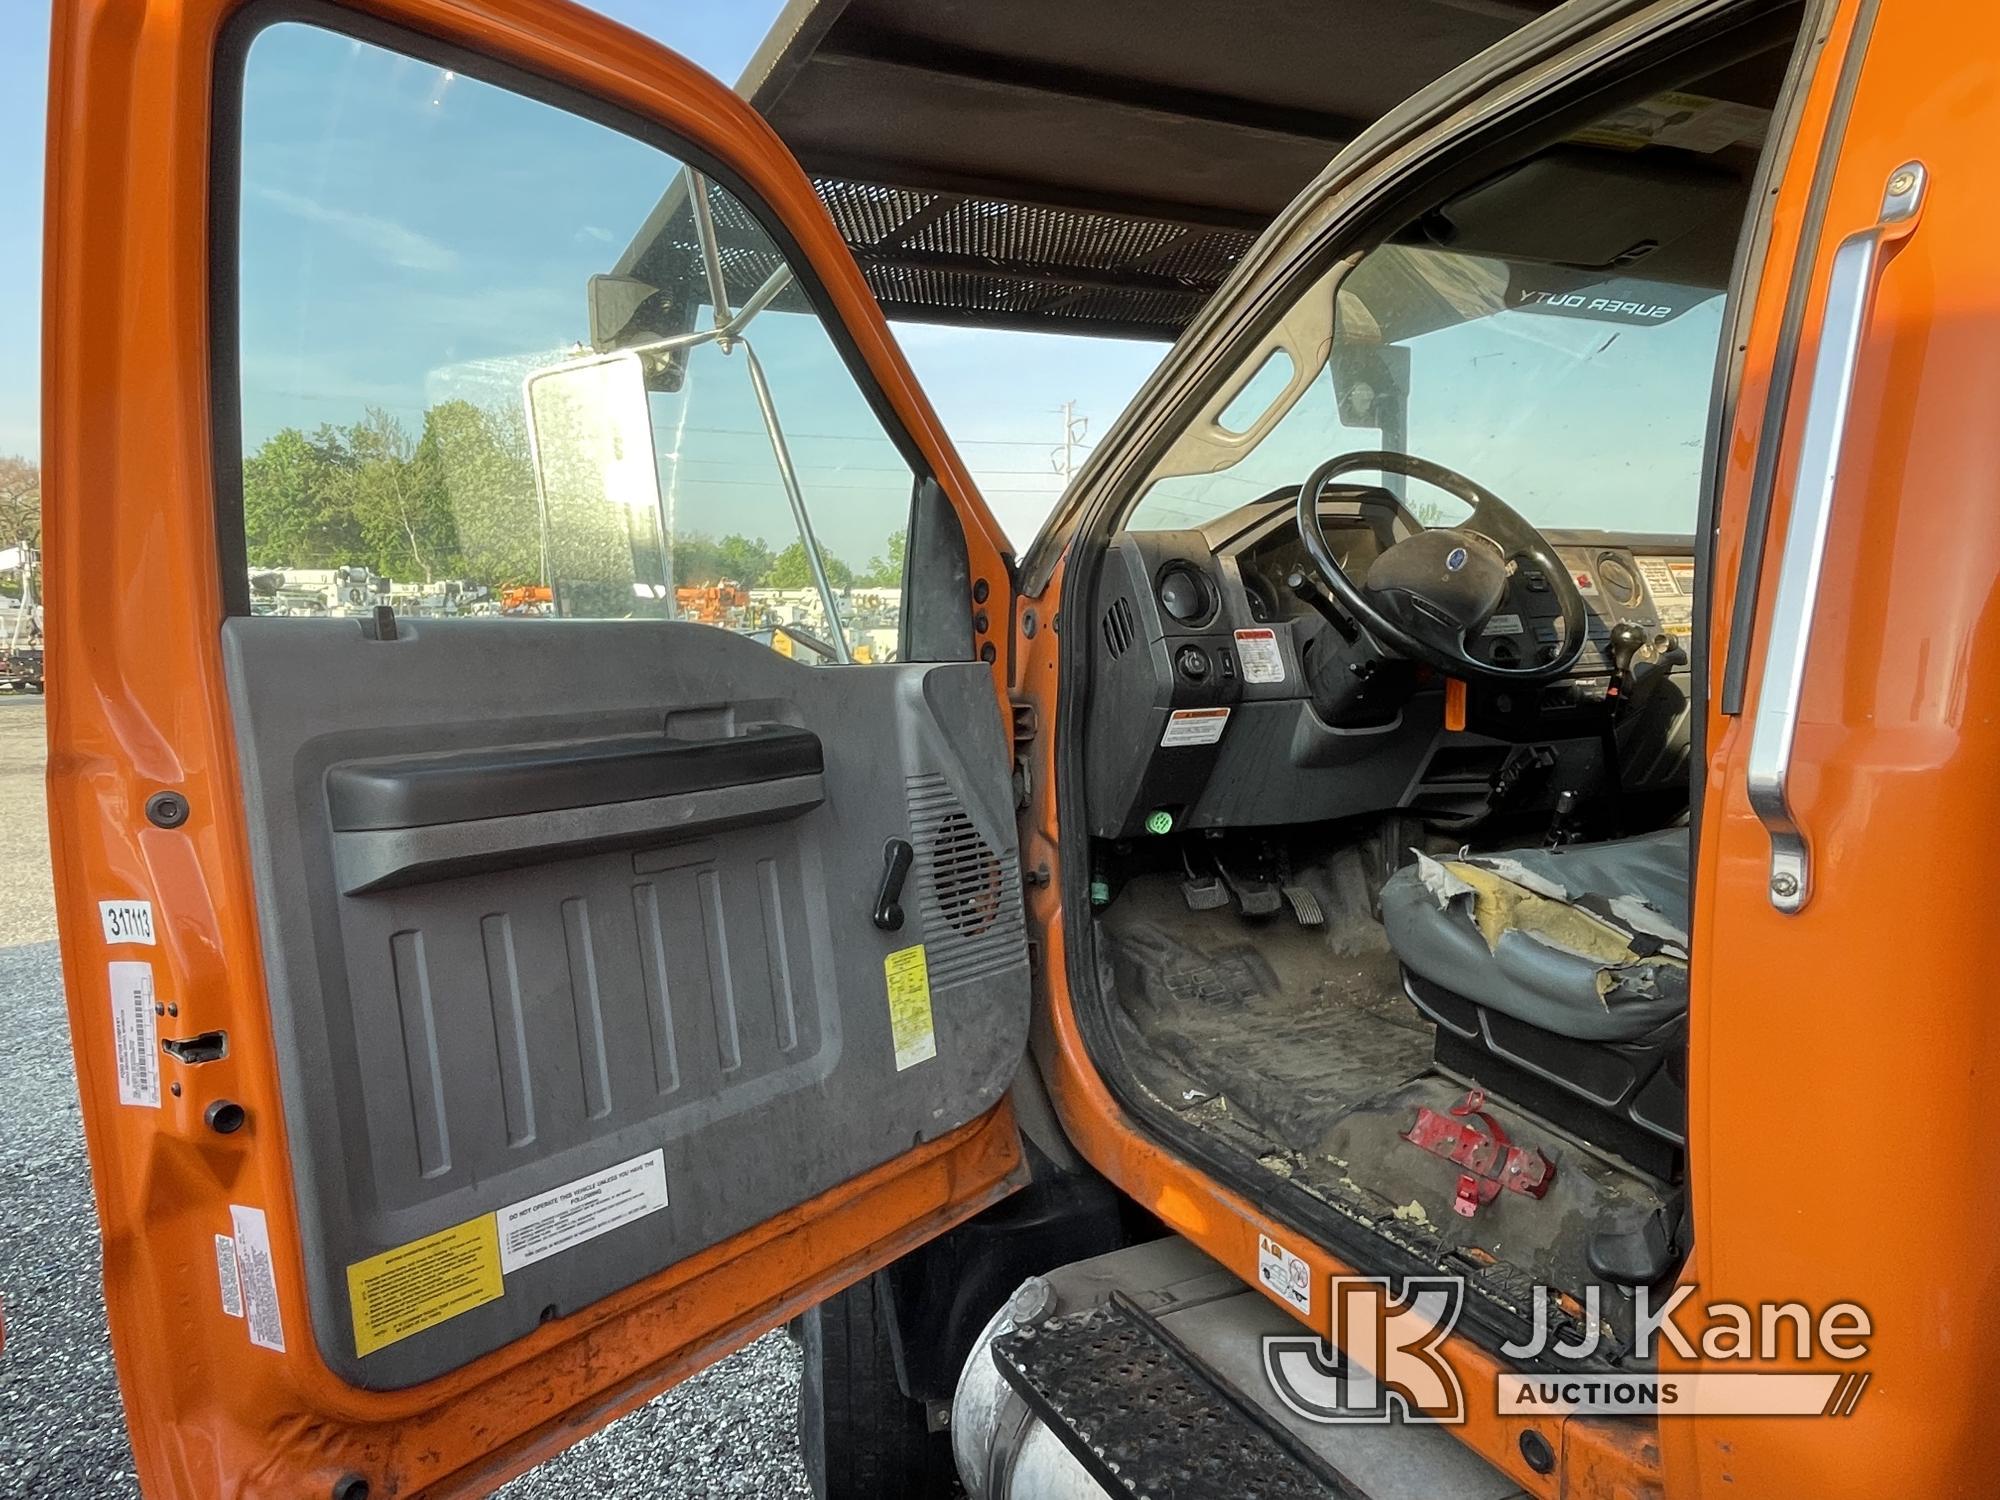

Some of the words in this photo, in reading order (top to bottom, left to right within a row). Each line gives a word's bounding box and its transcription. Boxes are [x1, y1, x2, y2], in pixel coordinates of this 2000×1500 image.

[108, 908, 150, 937] 317113
[509, 1213, 518, 1221] DO
[519, 1207, 532, 1217] NOT
[532, 1197, 558, 1212] OPERATE
[574, 1183, 596, 1195] VEHICLE
[618, 1169, 630, 1177] YOU
[644, 1160, 654, 1168] THE
